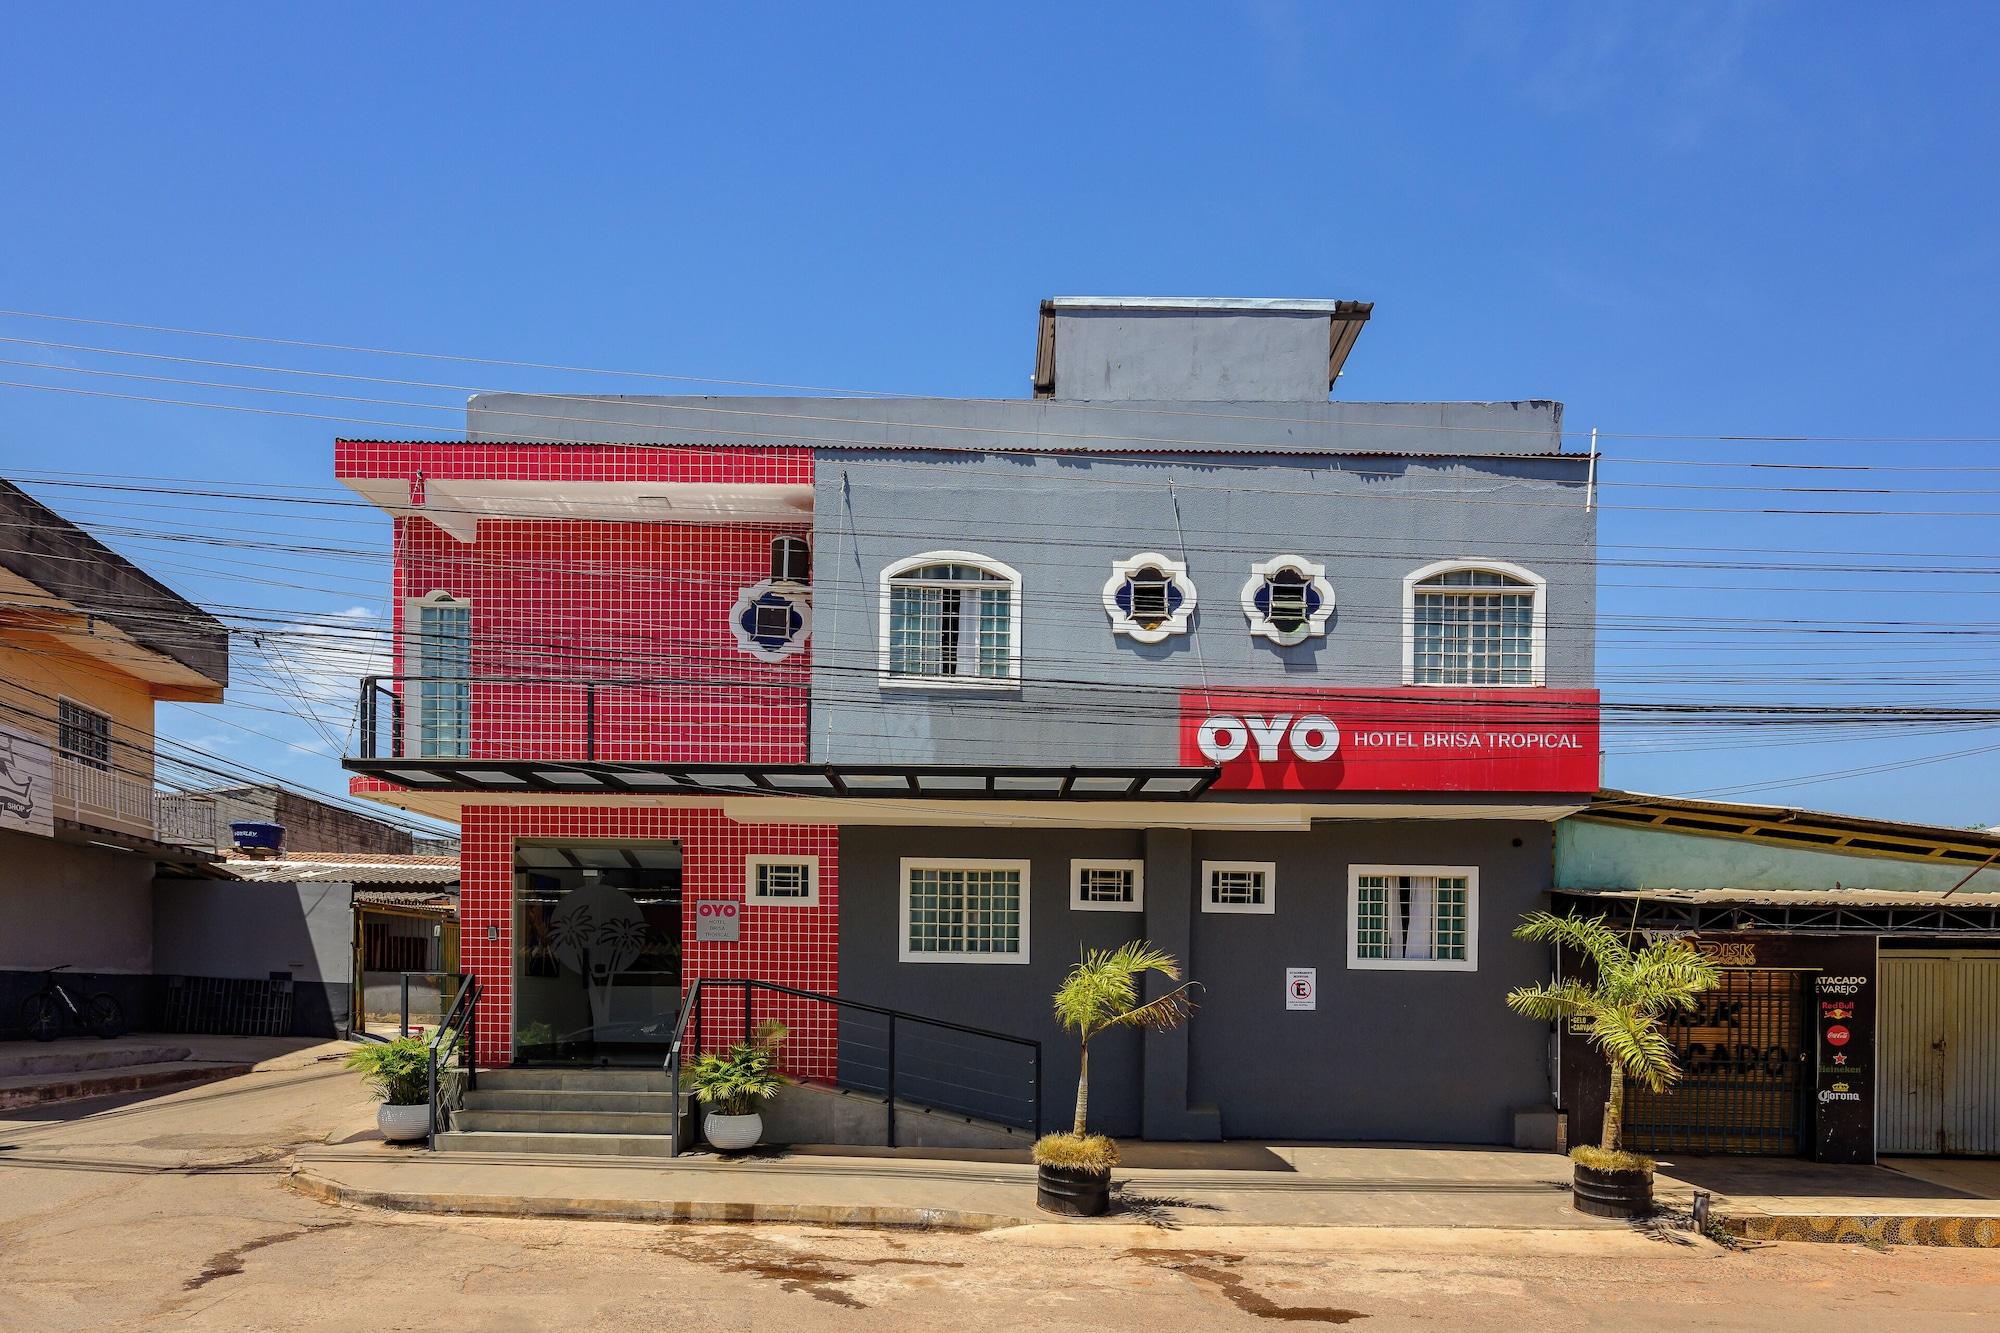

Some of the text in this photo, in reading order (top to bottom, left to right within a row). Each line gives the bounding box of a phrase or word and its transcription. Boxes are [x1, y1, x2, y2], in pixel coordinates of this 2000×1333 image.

[1197, 714, 1340, 762] OYO
[1354, 731, 1583, 749] HOTEL BRISA TROPICAL
[7, 802, 25, 812] SHOP
[700, 904, 736, 917] OYO
[1696, 941, 1756, 957] DISK
[1815, 976, 1867, 985] ATACADO
[1821, 985, 1858, 995] VAREJO
[1817, 1090, 1861, 1104] Corona
